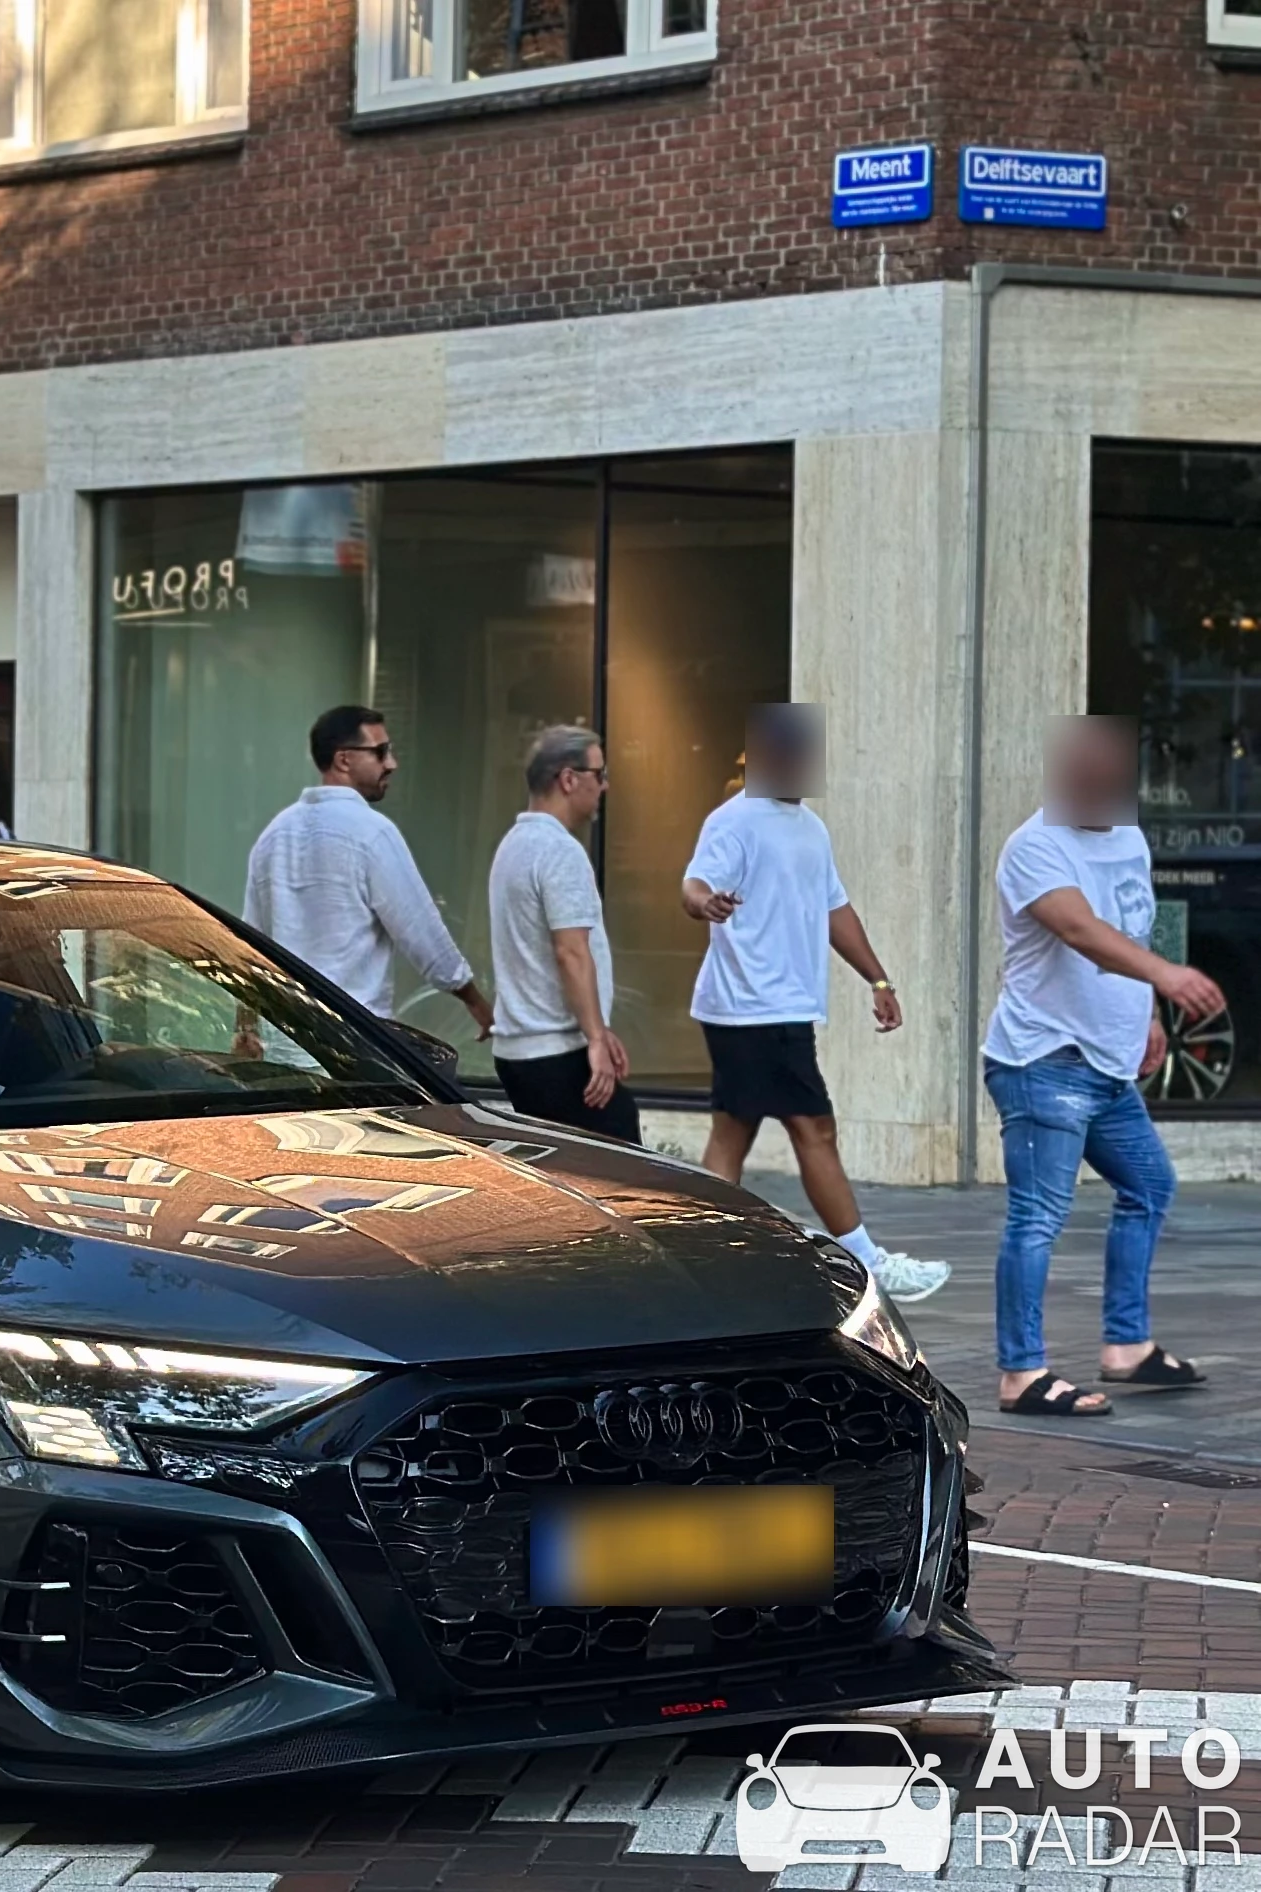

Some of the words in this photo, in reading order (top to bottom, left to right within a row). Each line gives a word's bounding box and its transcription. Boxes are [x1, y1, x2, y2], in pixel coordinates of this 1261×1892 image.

[852, 154, 911, 181] Meent
[974, 156, 1097, 186] Delftsevaart
[1166, 827, 1201, 853] zijn
[1205, 825, 1244, 847] NIO
